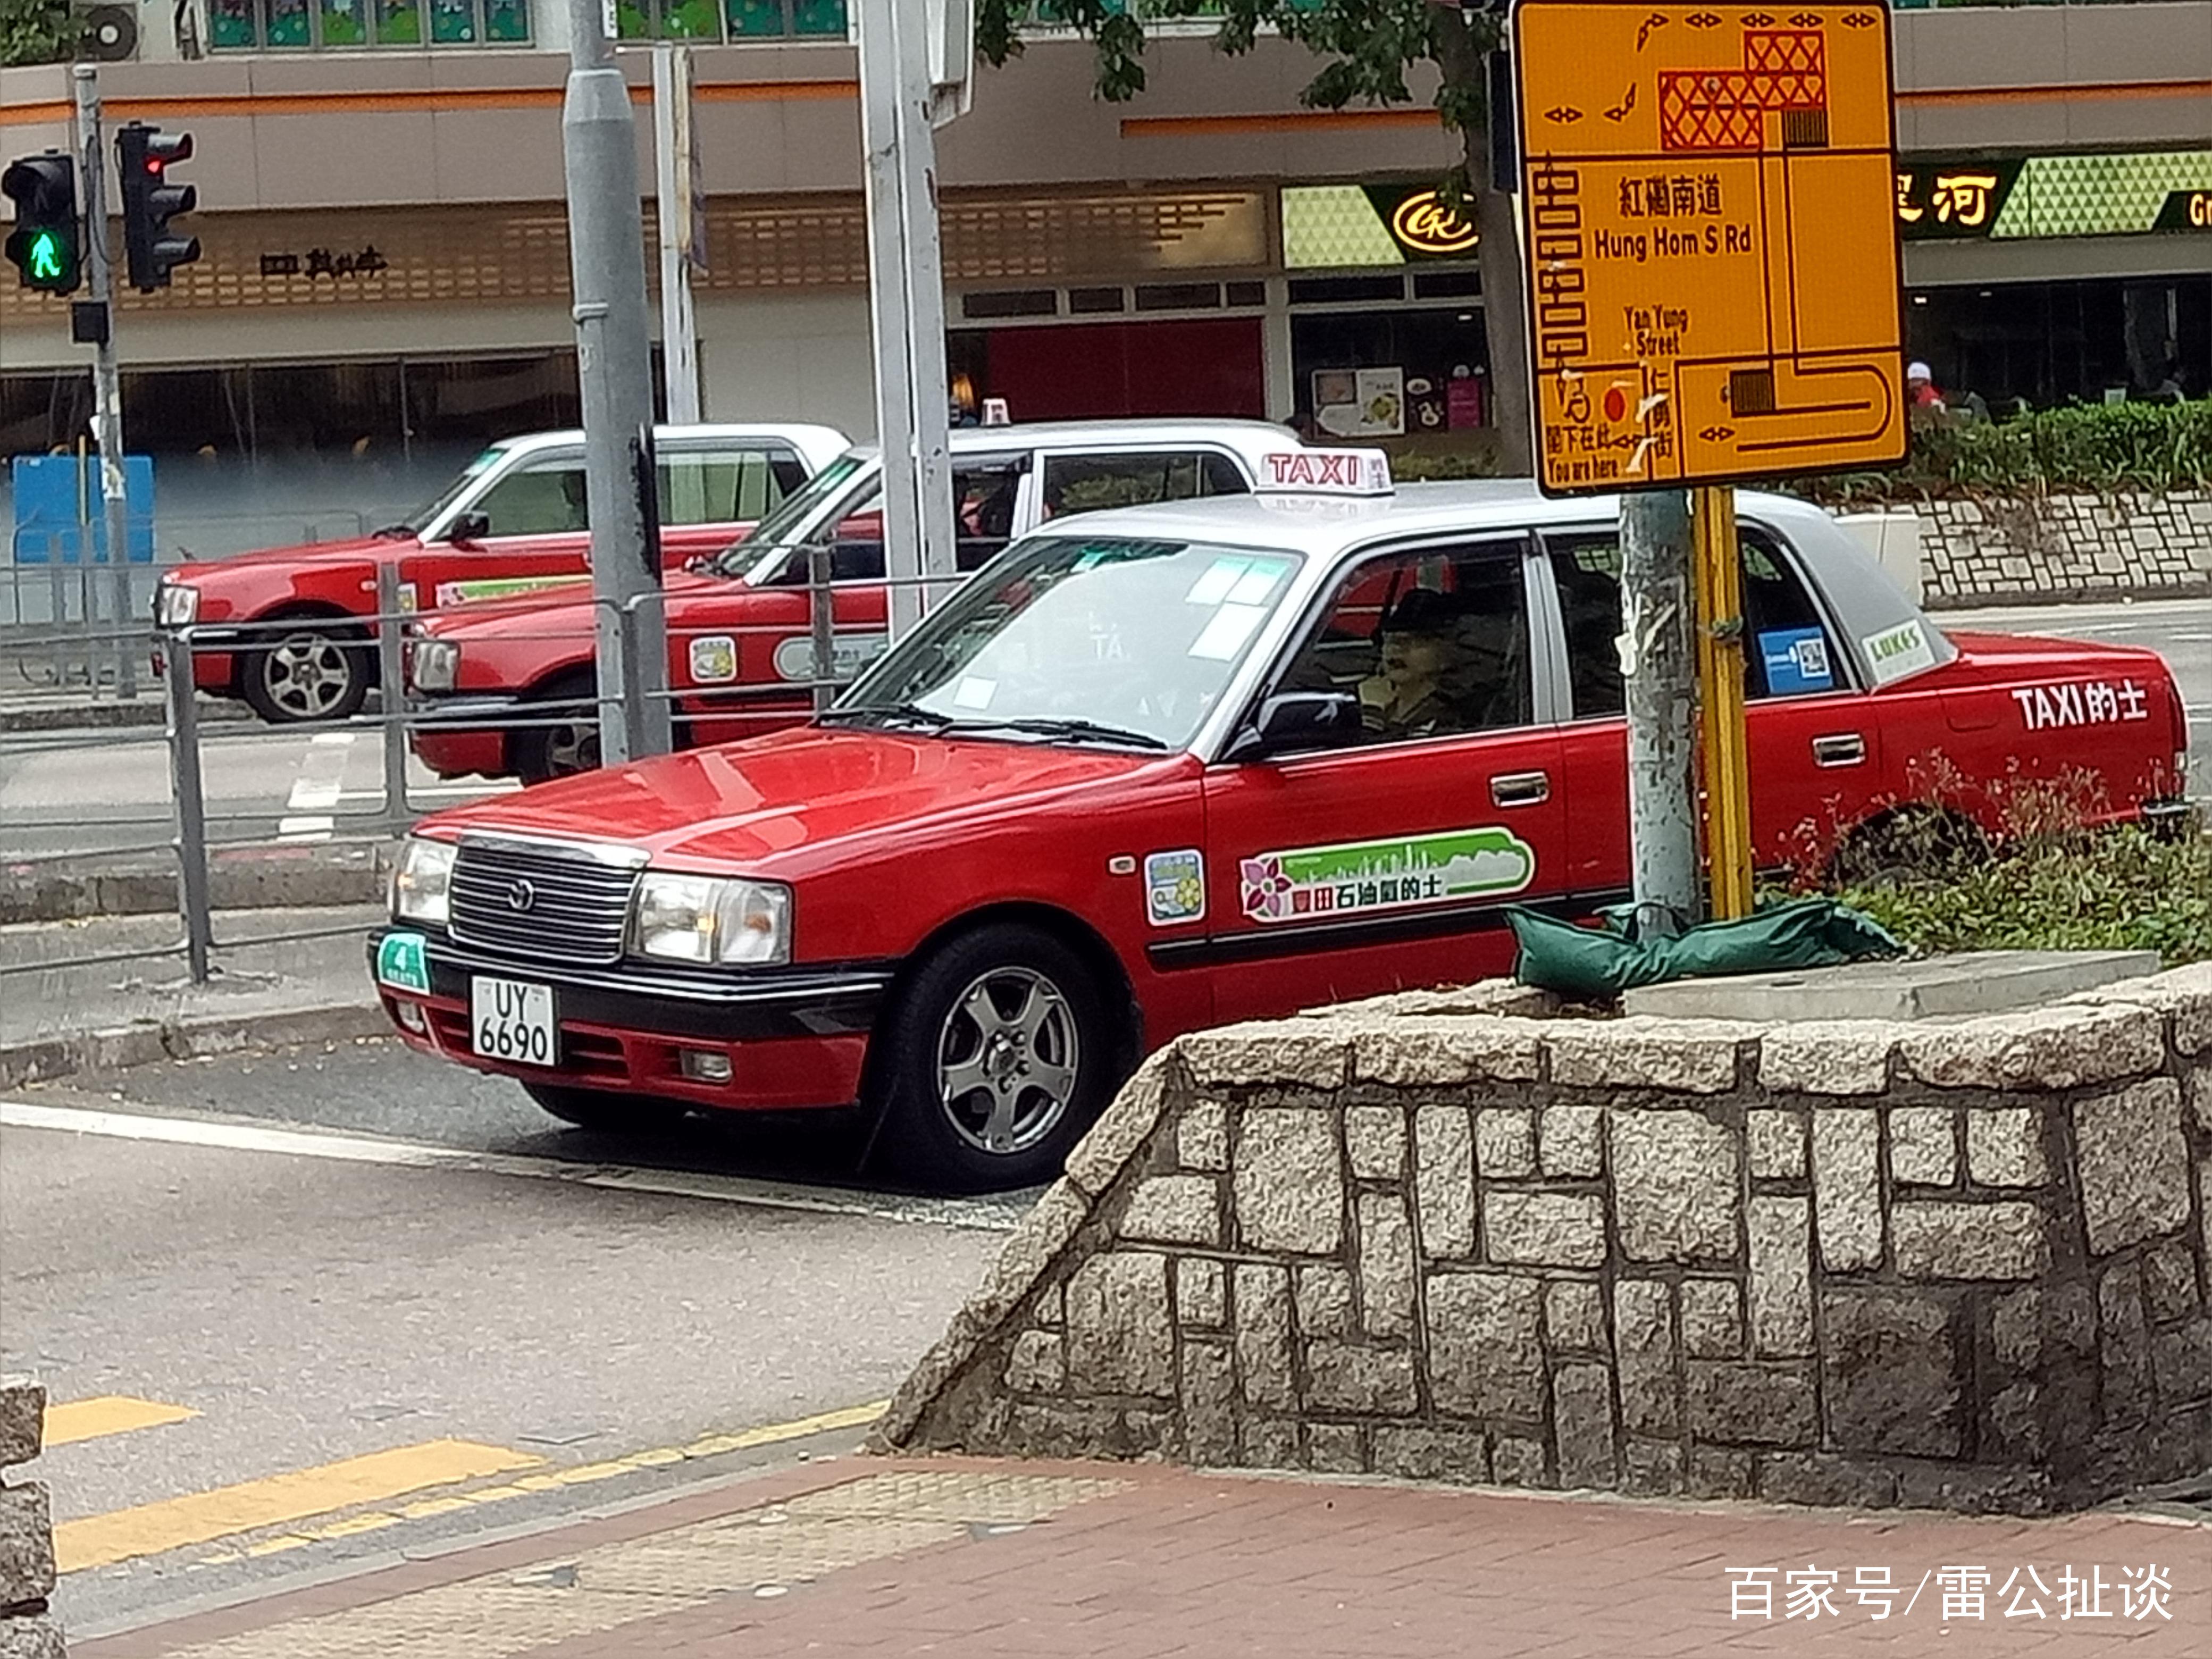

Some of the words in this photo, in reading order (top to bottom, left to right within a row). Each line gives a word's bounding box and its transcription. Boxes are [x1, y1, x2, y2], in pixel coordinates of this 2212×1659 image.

[1595, 229, 1646, 262] Hung
[1654, 227, 1698, 256] Hom
[1705, 224, 1719, 254] S
[1725, 223, 1751, 253] Rd
[1623, 306, 1650, 331] Yan
[1637, 330, 1680, 356] Street
[1268, 454, 1358, 485] TAXI
[394, 946, 407, 971] 4
[496, 982, 527, 1022] UY
[480, 1016, 548, 1061] 6690
